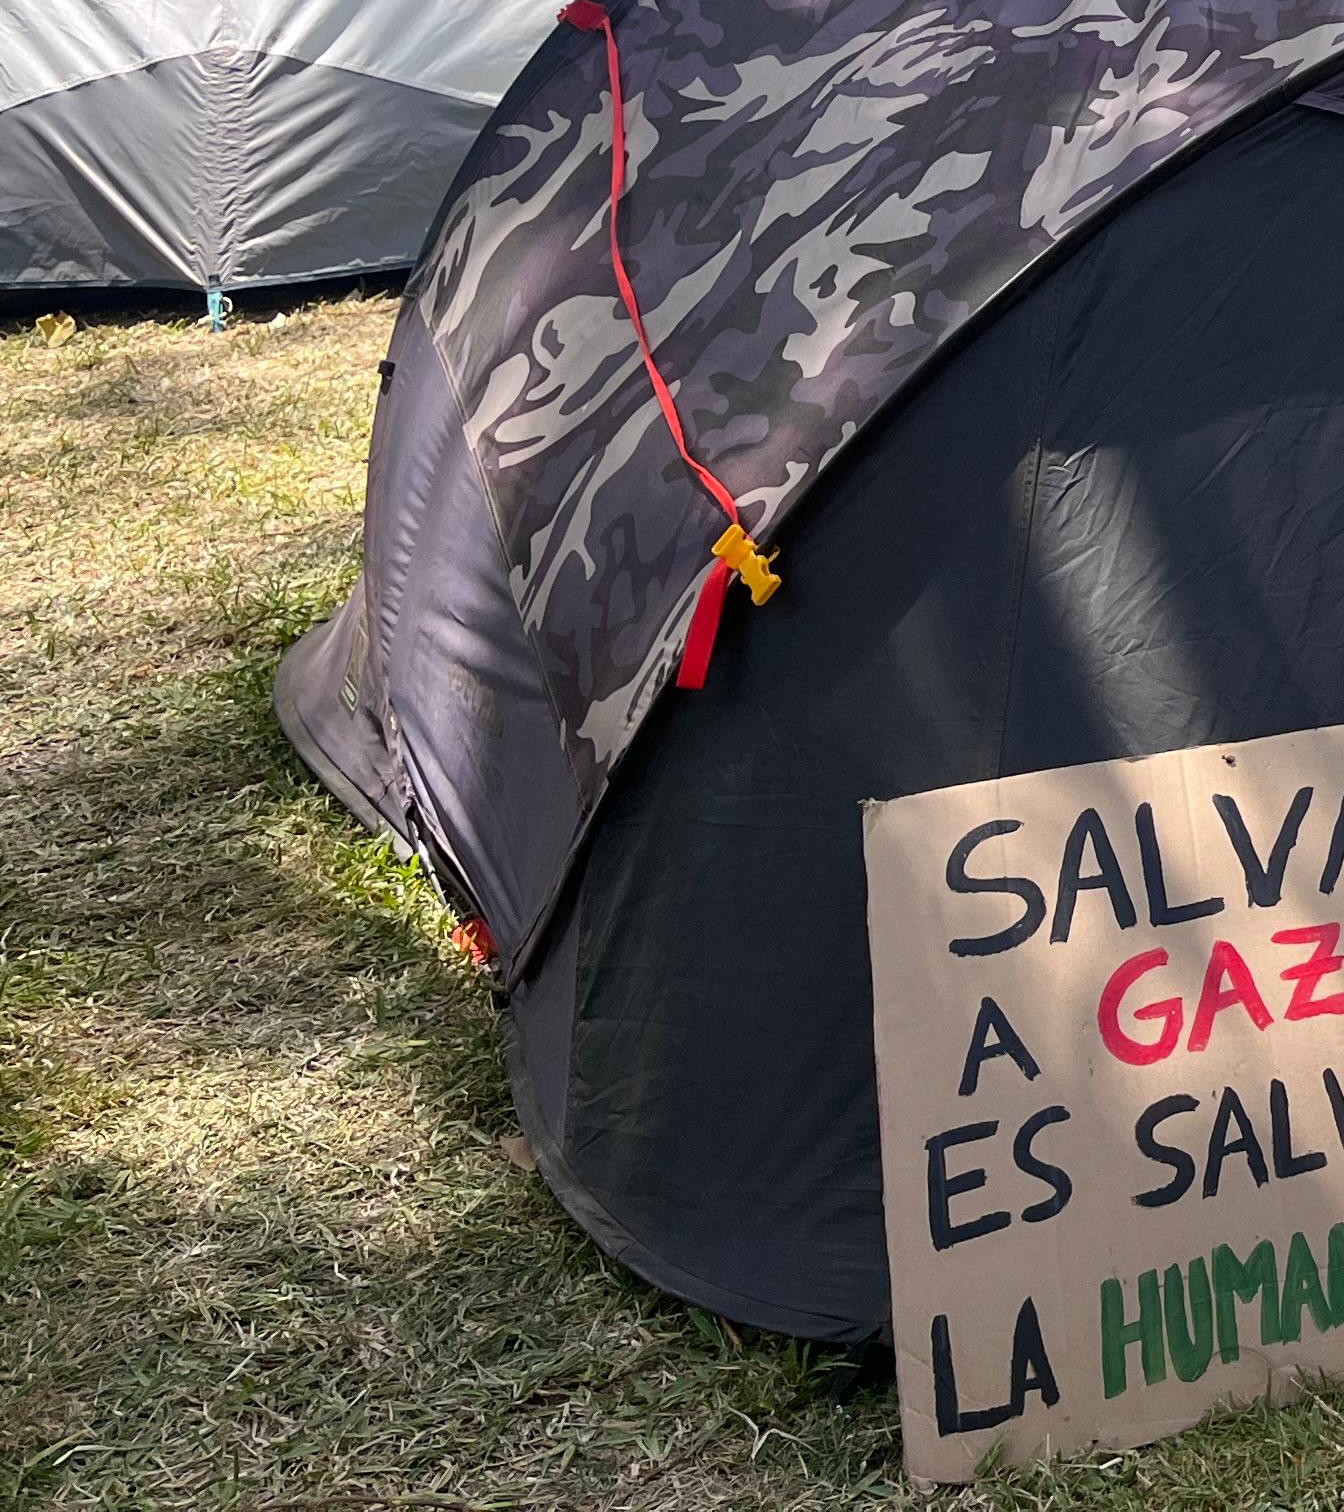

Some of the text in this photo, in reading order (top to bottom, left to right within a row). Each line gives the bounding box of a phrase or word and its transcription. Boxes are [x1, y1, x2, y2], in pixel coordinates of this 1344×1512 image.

[958, 996, 1042, 1097] A
[925, 1106, 1073, 1251] ES
[931, 1297, 1061, 1437] LA
